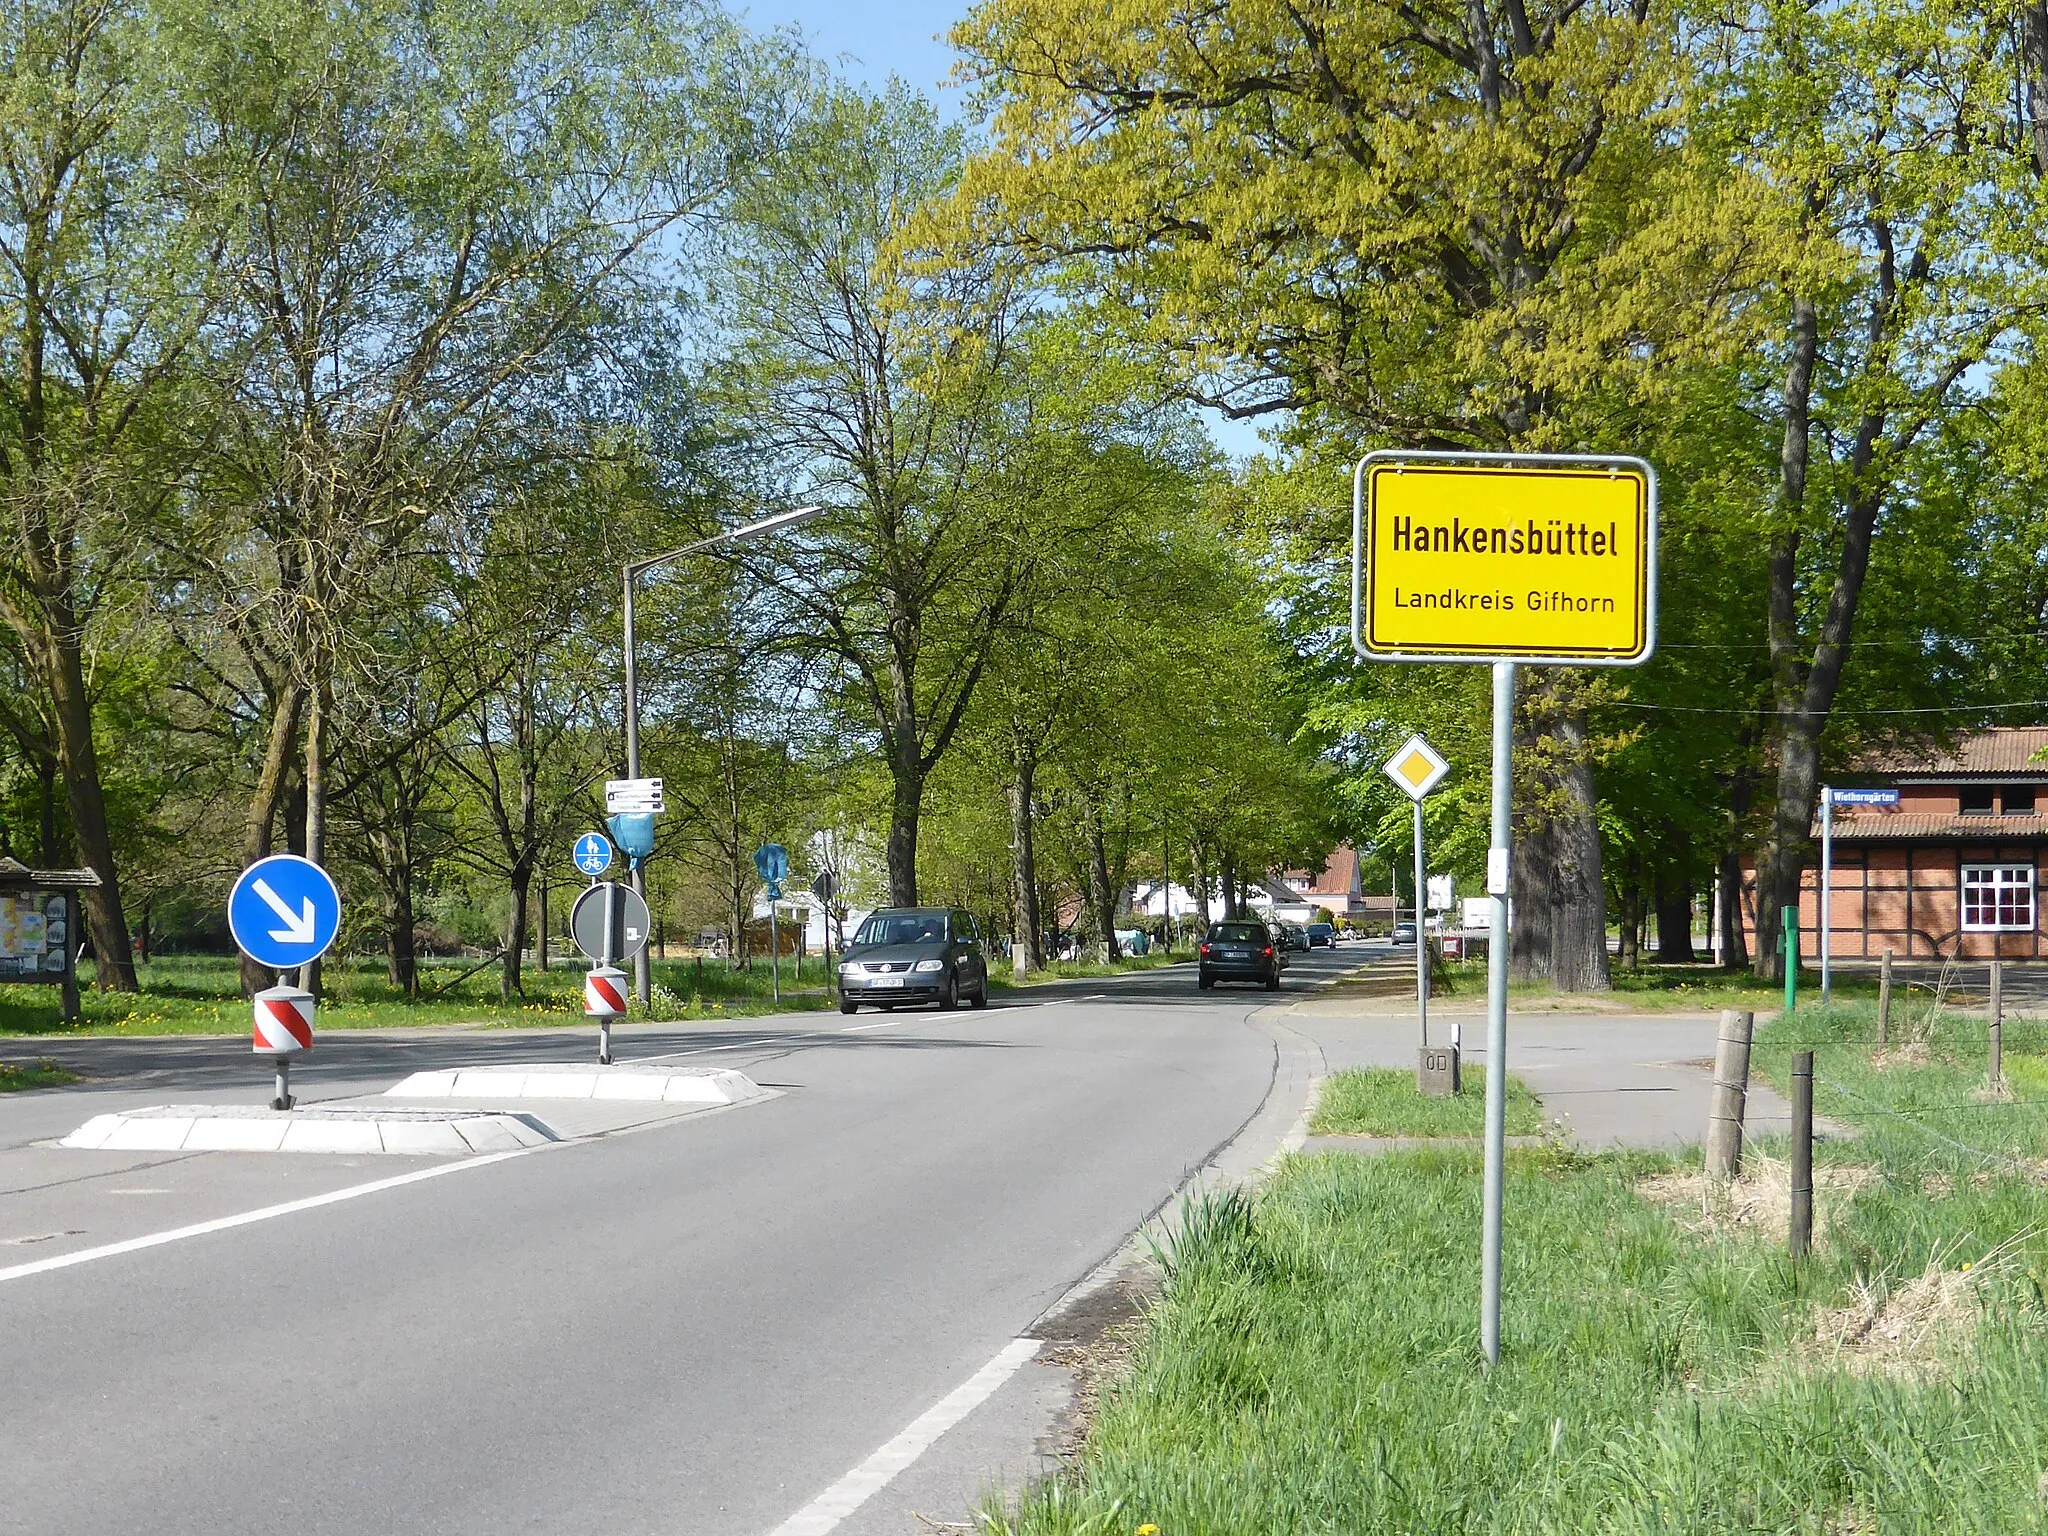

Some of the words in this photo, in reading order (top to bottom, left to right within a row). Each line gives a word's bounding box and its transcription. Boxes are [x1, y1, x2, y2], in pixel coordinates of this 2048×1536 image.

[1393, 515, 1618, 557] Hankensbüttel
[1395, 587, 1514, 611] Landkreis
[1527, 589, 1615, 613] Gifhorn
[1833, 792, 1895, 803] Wiethorngärten
